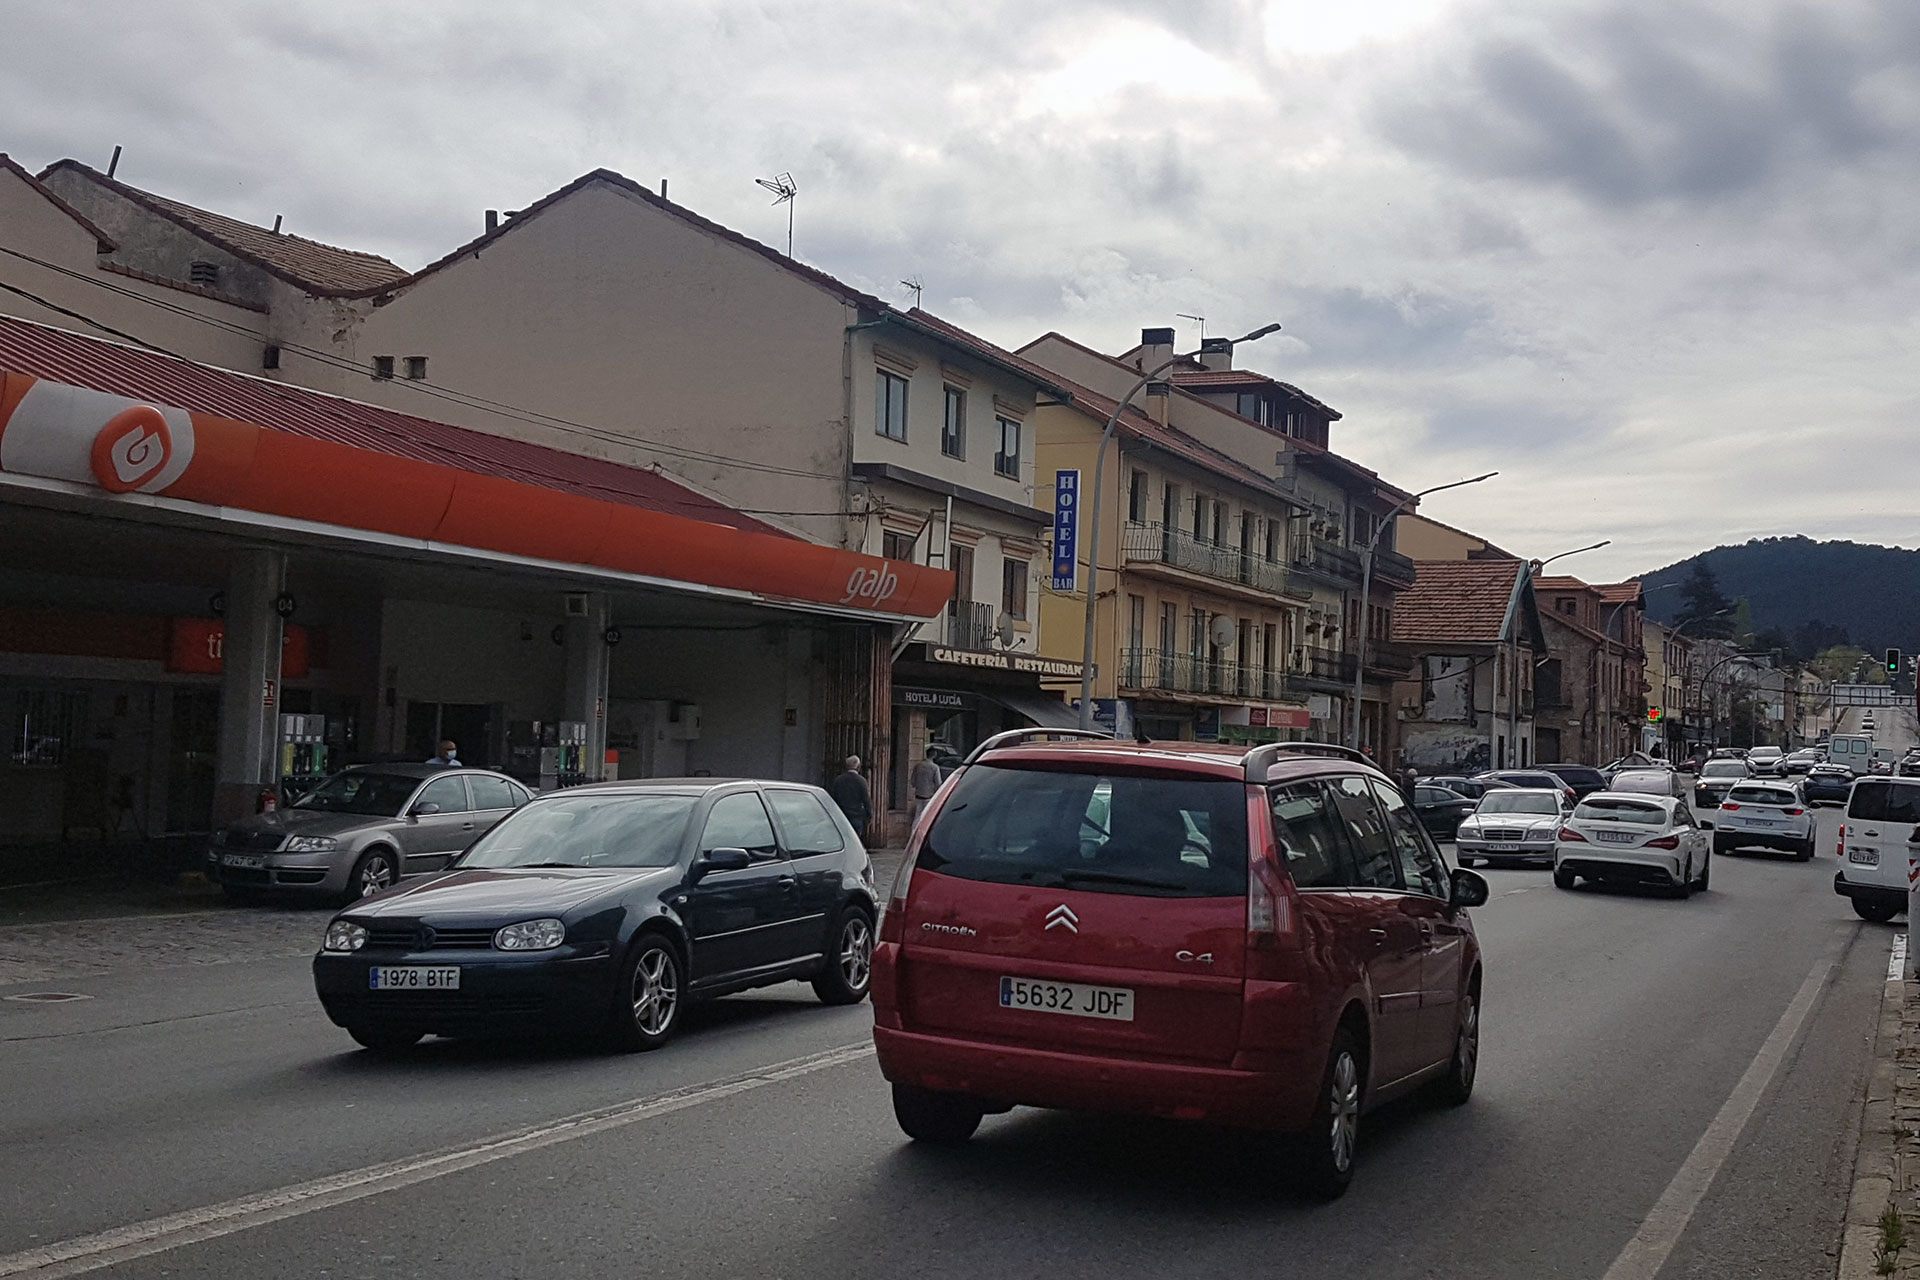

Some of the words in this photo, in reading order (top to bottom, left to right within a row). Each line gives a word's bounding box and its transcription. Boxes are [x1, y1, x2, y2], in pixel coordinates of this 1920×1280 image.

[1058, 475, 1075, 559] HOTEL
[839, 561, 898, 608] galp
[1053, 577, 1073, 589] BAR
[278, 599, 293, 611] 04
[934, 649, 1008, 668] CAFETERÍA
[905, 692, 932, 703] HOTEL
[921, 922, 977, 937] CITROËN
[1175, 950, 1214, 965] C4
[382, 969, 418, 986] 1978
[427, 969, 456, 986] BTF
[1016, 982, 1074, 1010] 5632
[1083, 990, 1127, 1015] JDF
